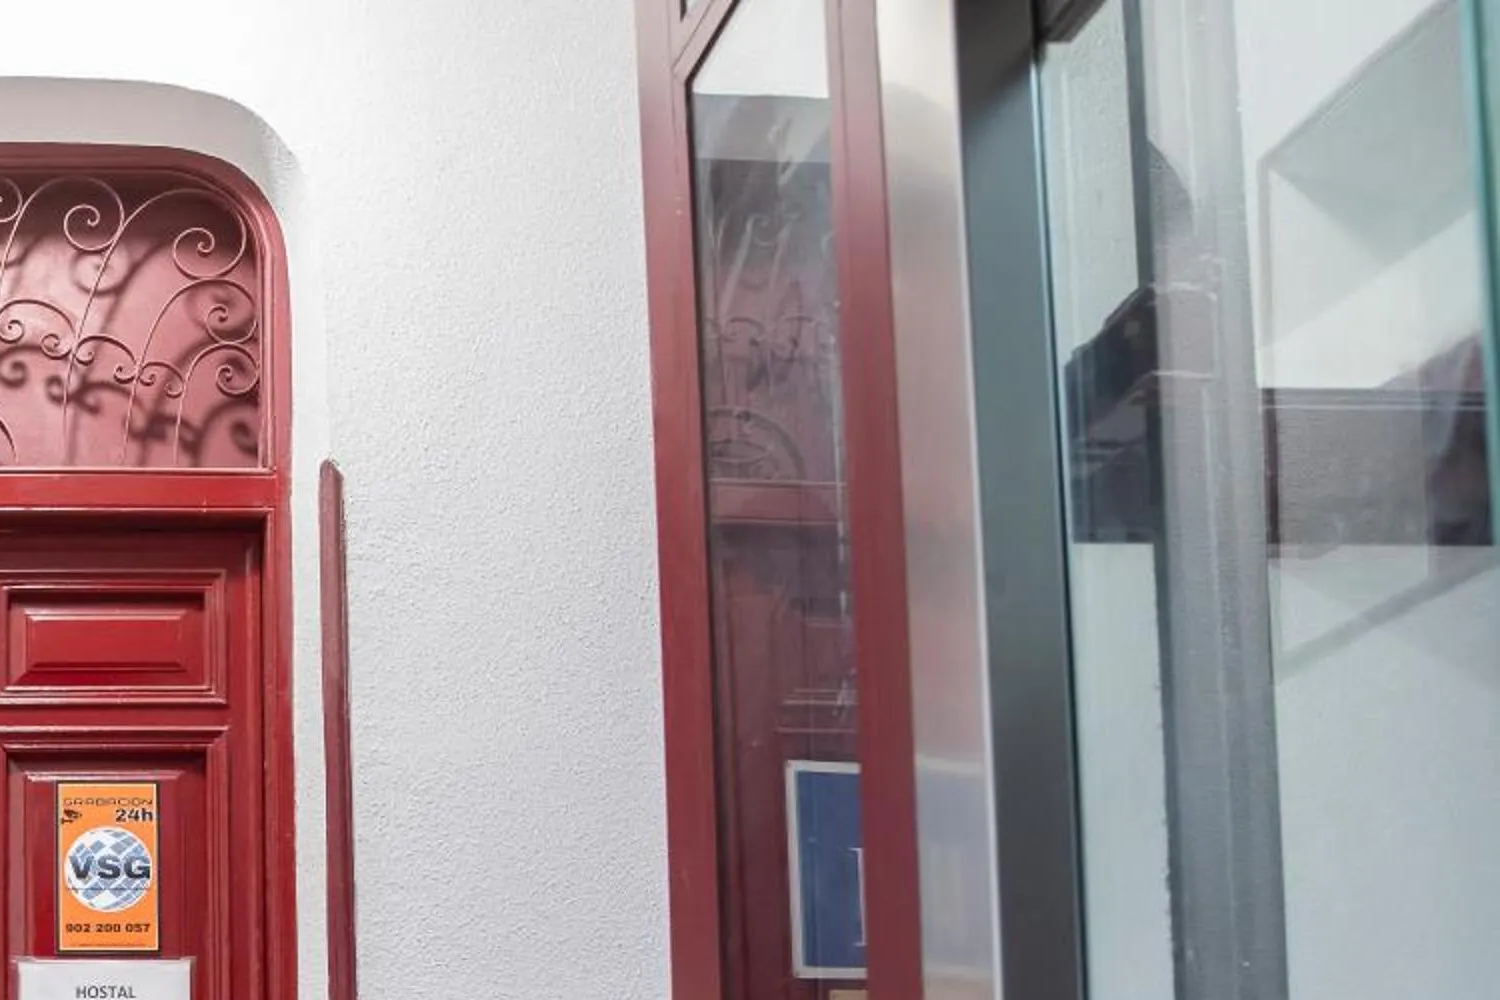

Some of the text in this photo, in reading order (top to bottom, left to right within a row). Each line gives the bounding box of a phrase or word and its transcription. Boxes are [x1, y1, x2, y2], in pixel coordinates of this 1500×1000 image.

[115, 808, 153, 822] 24h
[68, 855, 151, 879] VSG
[75, 985, 137, 999] HOSTAL
